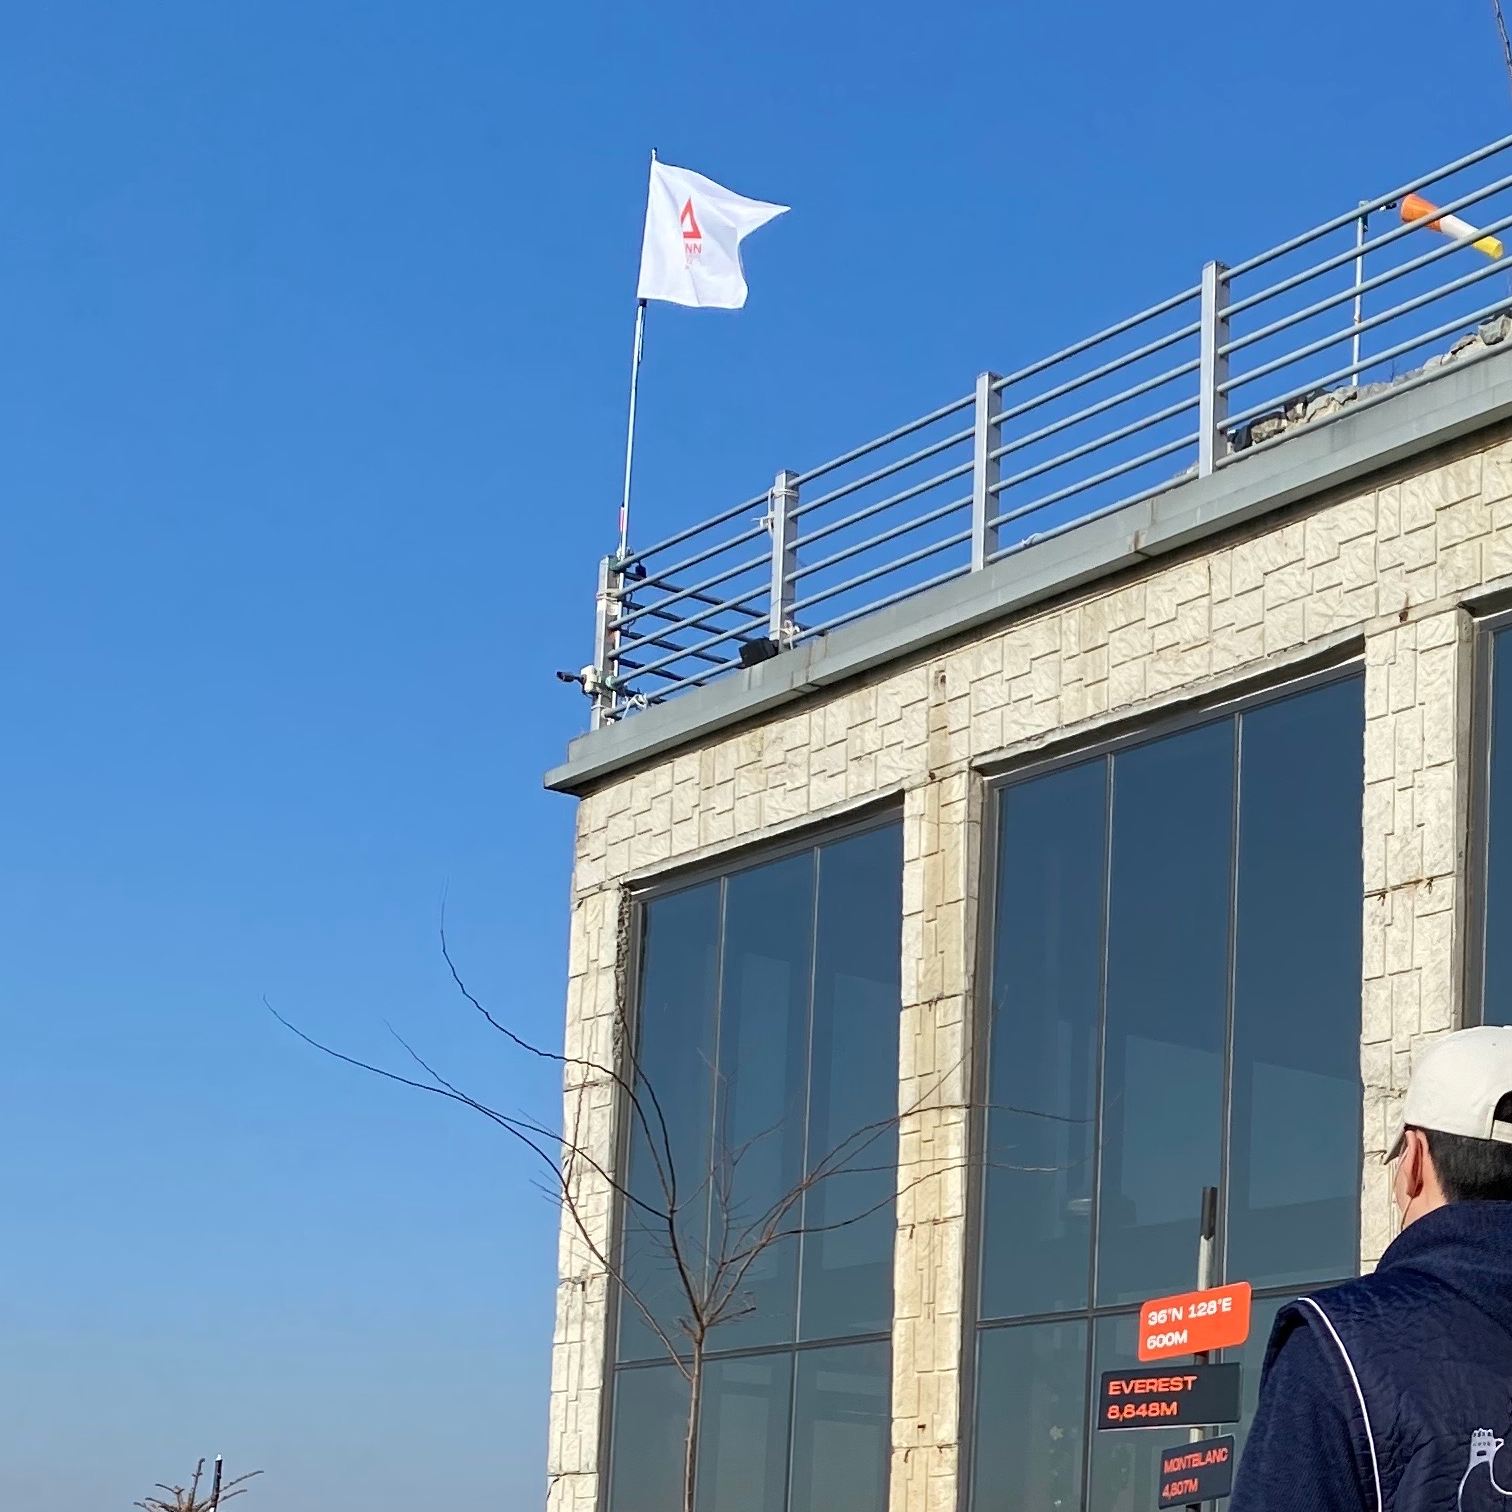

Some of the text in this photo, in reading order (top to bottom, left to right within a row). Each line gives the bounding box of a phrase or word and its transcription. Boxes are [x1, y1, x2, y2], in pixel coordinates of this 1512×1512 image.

[1146, 1329, 1188, 1350] 600M
[1108, 1375, 1198, 1395] EVEREST
[1163, 1447, 1229, 1474] MONTBLANC
